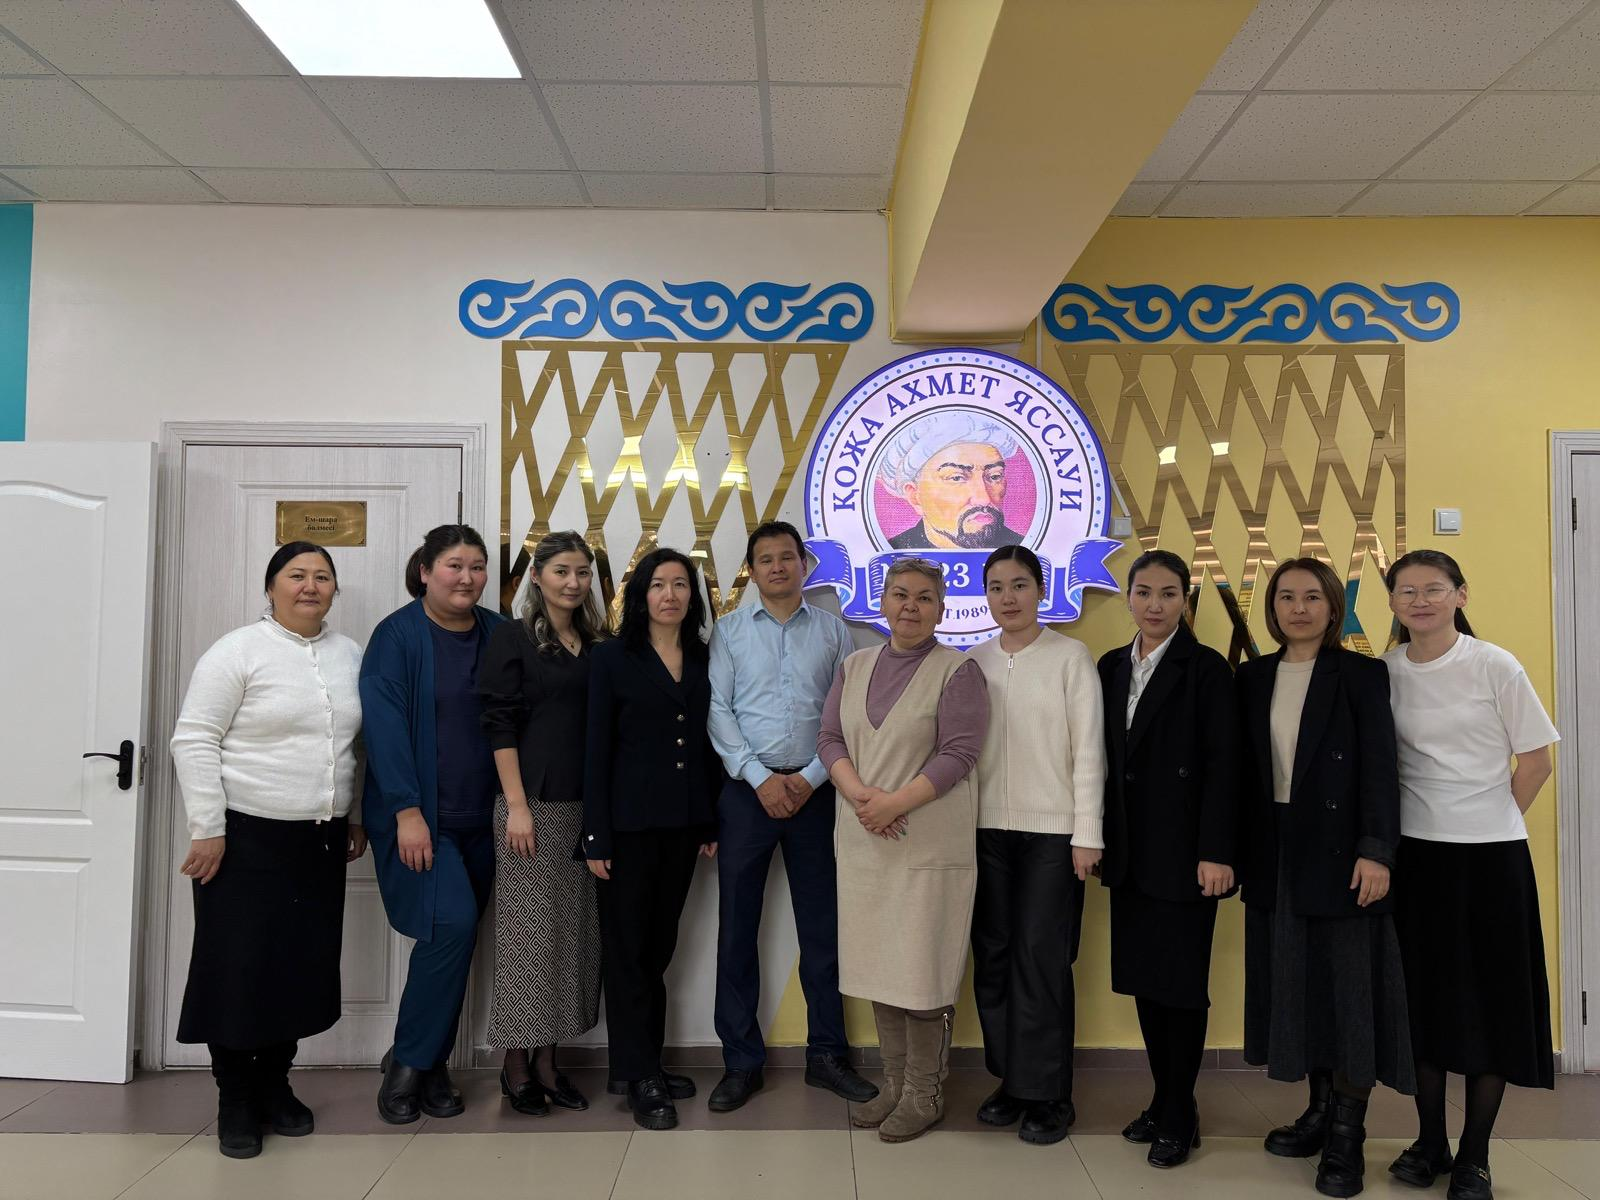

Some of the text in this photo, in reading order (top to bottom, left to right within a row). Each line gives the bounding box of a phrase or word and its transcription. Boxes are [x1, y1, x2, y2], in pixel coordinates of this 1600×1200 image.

[833, 372, 1083, 512] ҚОЖА АХМЕТ ЯССАУИ
